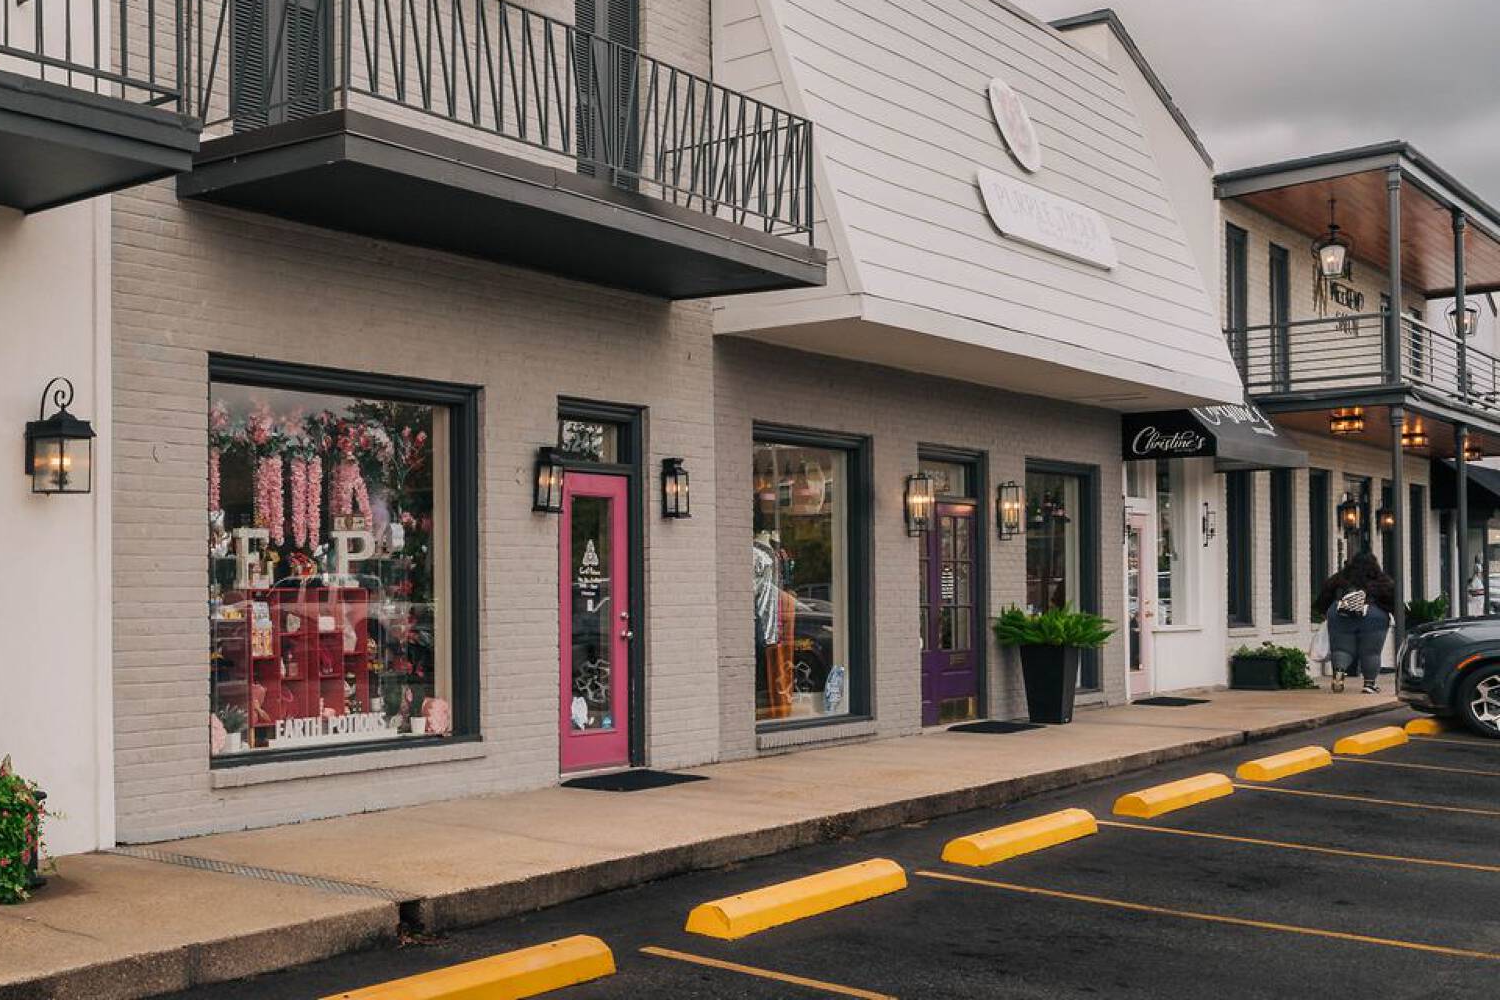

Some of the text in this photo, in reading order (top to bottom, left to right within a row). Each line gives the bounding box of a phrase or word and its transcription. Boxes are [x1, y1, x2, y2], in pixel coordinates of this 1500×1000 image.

[1132, 426, 1206, 455] Christine's
[275, 711, 388, 741] EARTH POTIONS
